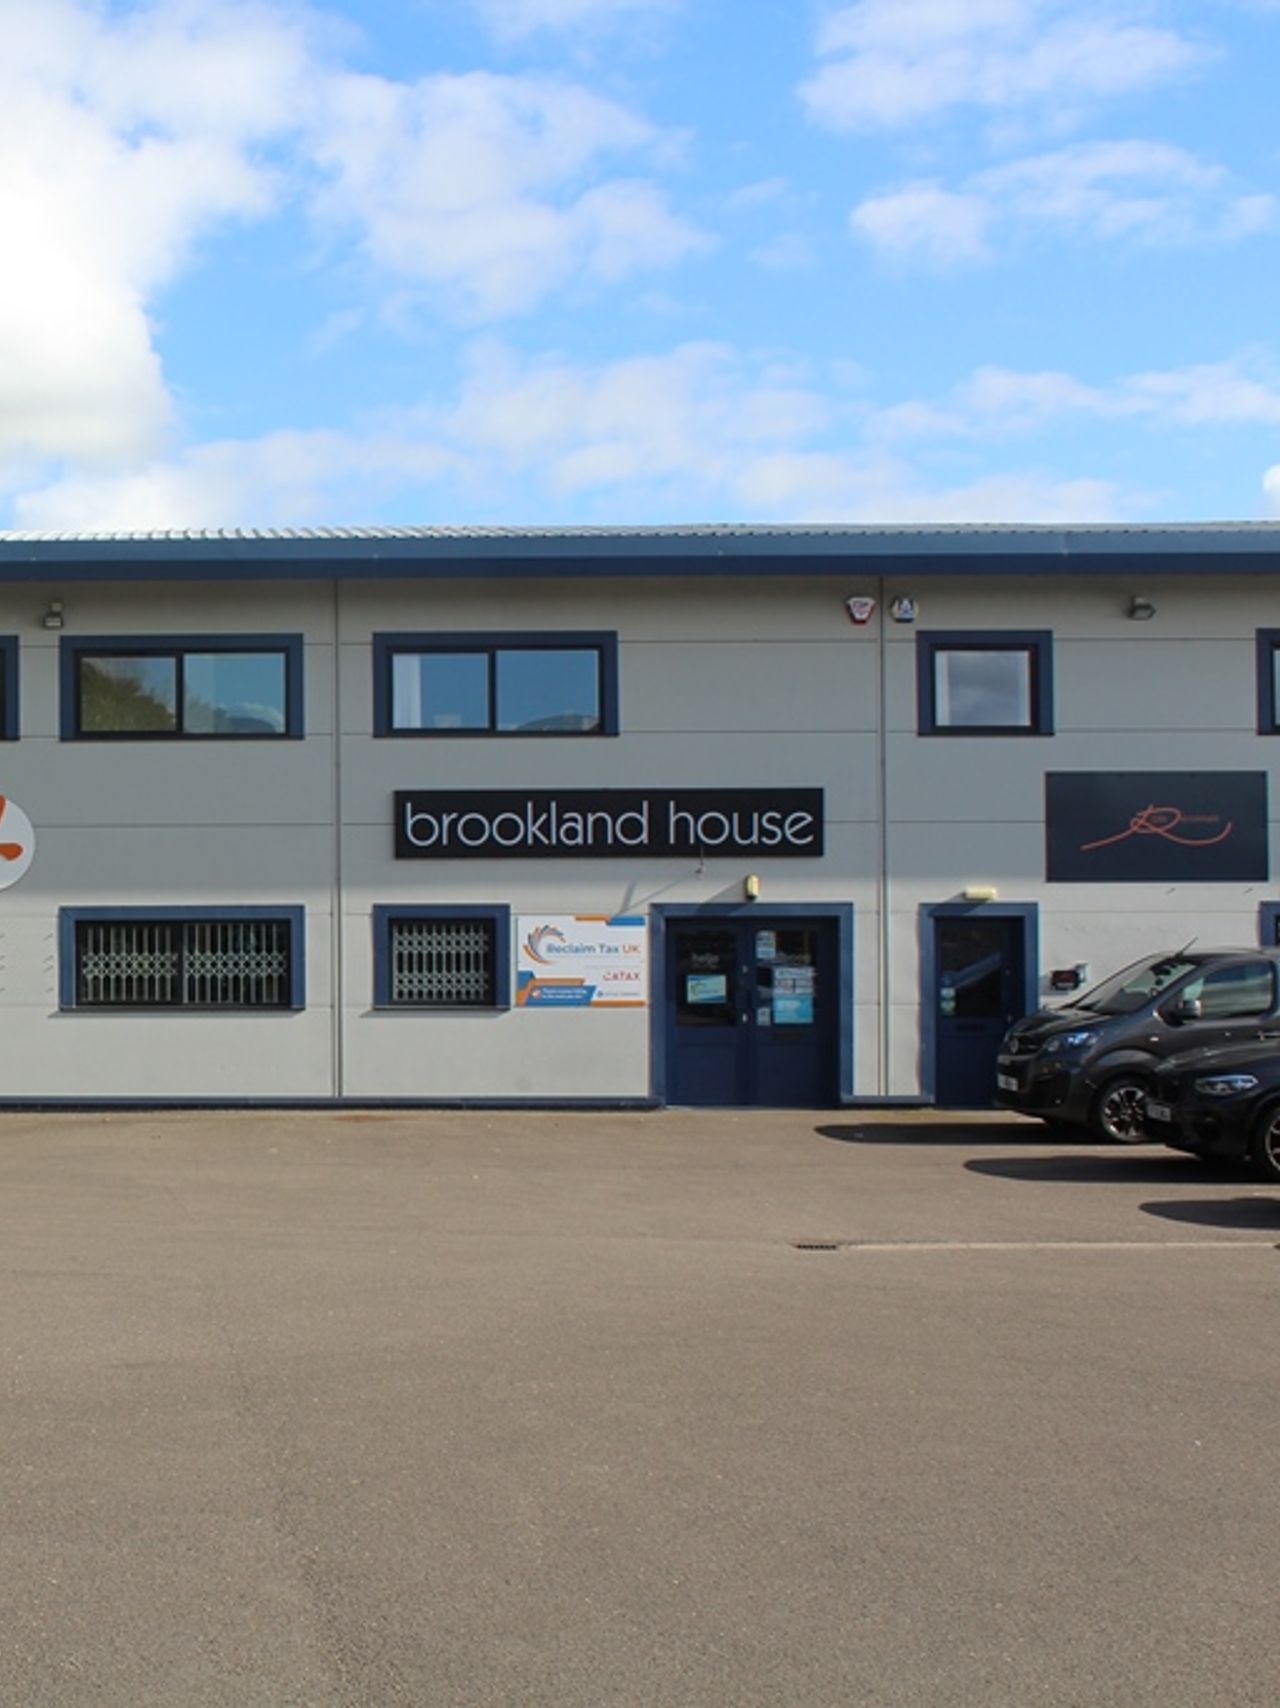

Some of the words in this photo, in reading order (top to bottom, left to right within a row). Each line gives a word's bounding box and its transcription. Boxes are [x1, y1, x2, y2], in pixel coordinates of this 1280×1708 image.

[405, 801, 649, 847] brookland
[669, 801, 815, 846] house
[547, 943, 596, 954] Reclaim
[600, 943, 619, 954] Tax
[623, 943, 641, 954] UK
